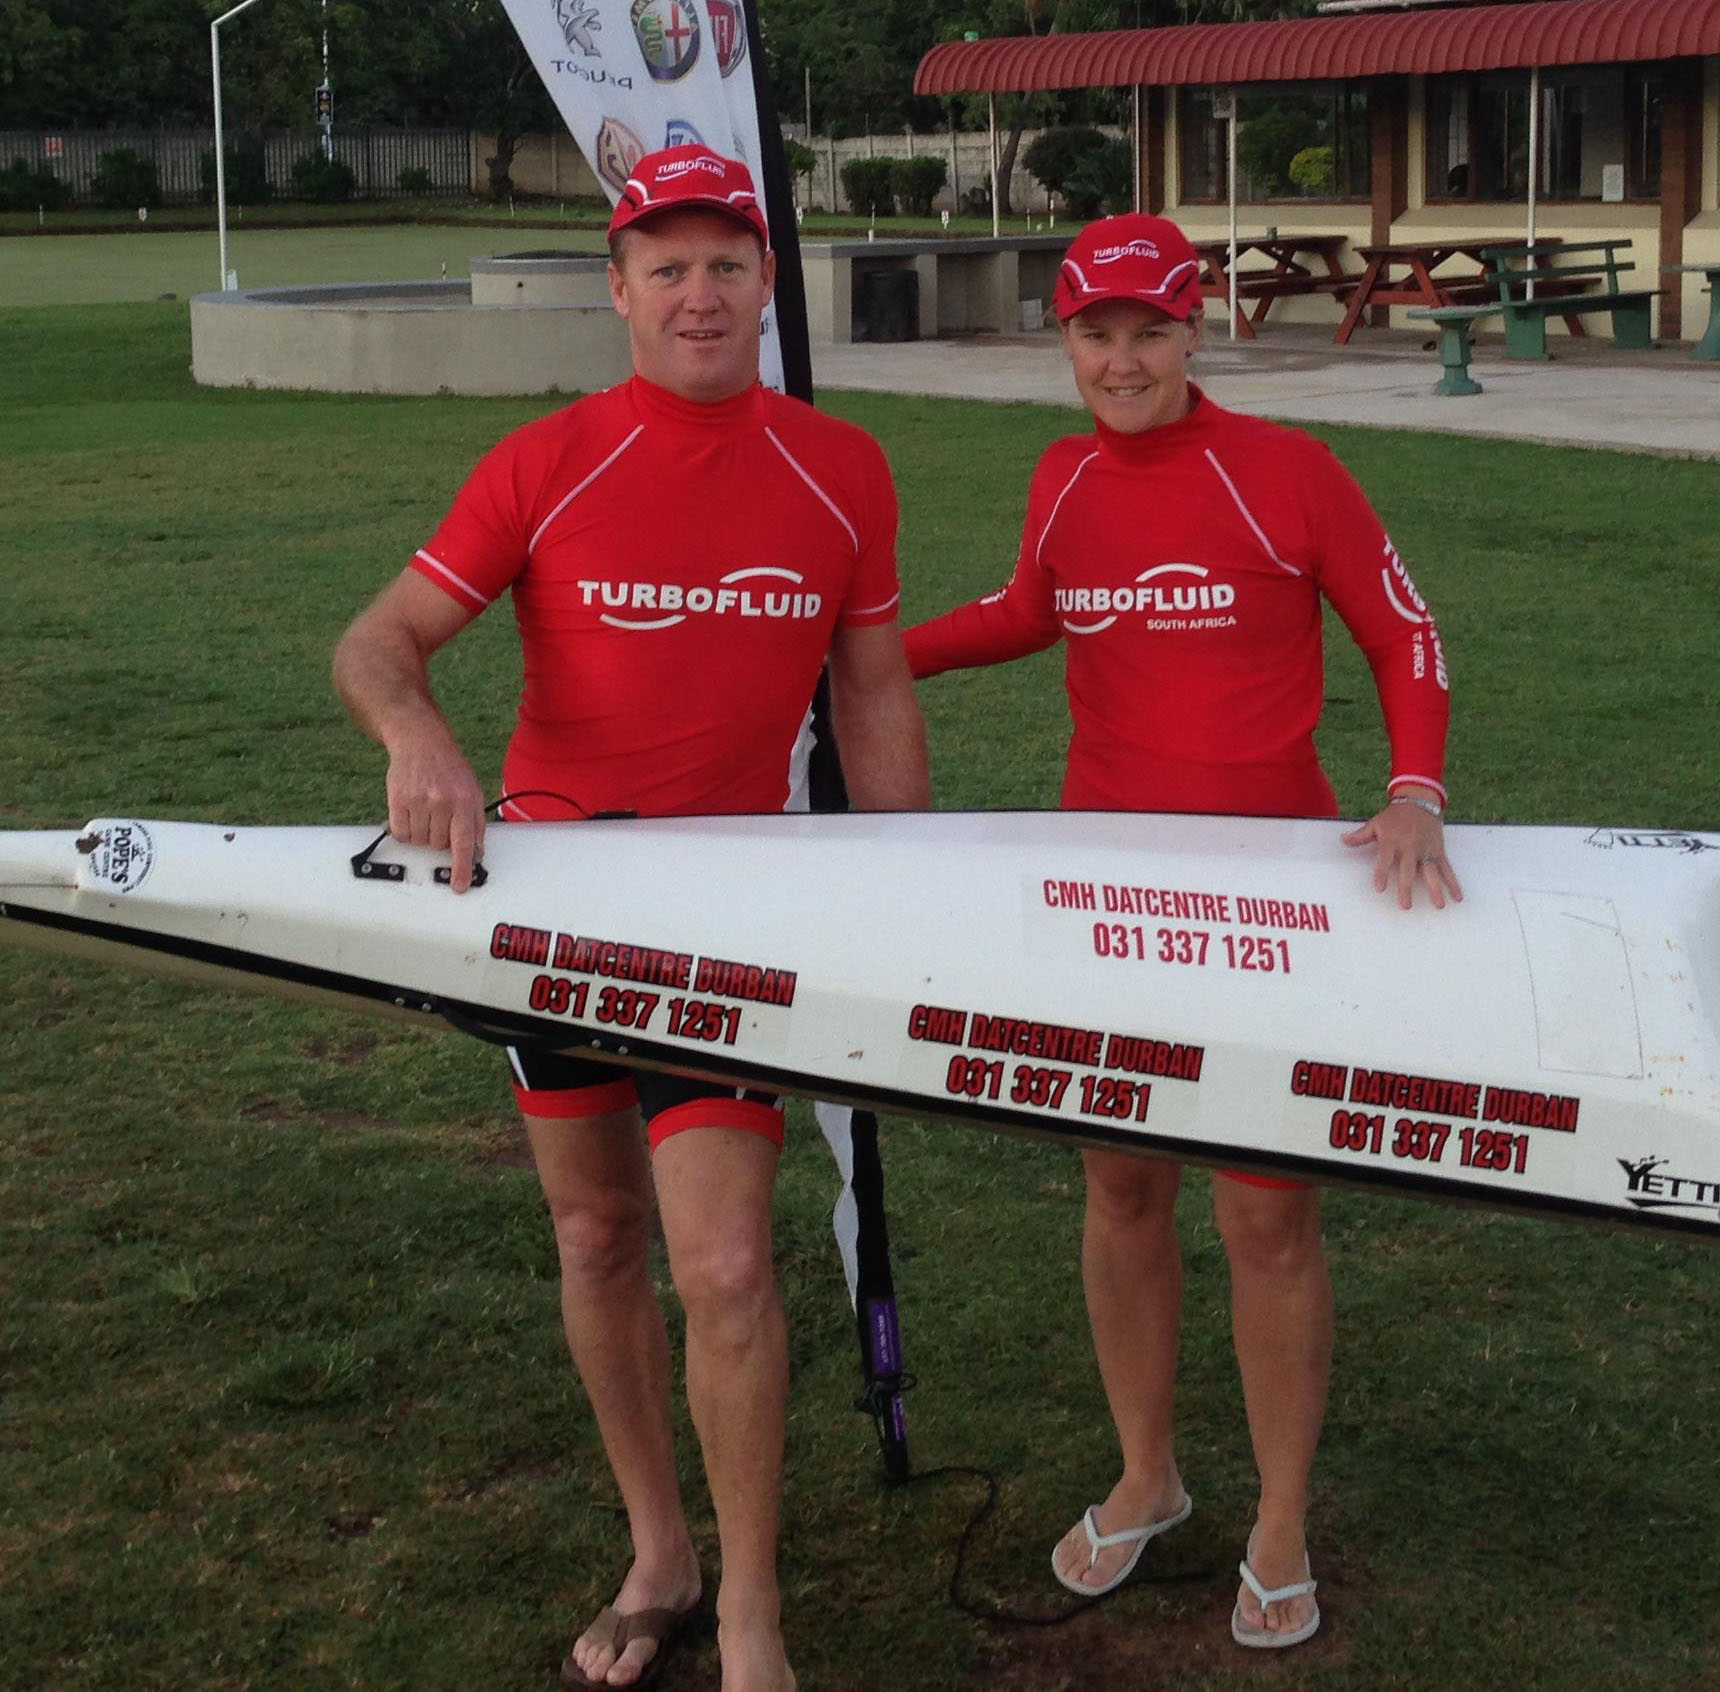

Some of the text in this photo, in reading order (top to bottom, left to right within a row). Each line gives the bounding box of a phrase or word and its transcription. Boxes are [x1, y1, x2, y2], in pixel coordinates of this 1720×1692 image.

[1093, 246, 1160, 259] TURBOFLUID
[577, 580, 822, 618] TURBOFLUID
[1055, 583, 1235, 612] TURBOFLUID
[1146, 616, 1237, 630] SOUTH AFRICA
[1043, 879, 1330, 932] CMH DATCENTRE DURBAN
[490, 923, 798, 1008] CMH DATCENTRE DURBAN
[1093, 922, 1291, 974] 031 337 1251
[529, 975, 742, 1045] 031 337 1251
[908, 1004, 1205, 1082] CMH DATCENTRE DURBAN
[946, 1055, 1152, 1123] 031 337 1251
[1291, 1060, 1580, 1133] CMH DATCENTRE DURBAN
[1329, 1109, 1529, 1175] 031 337 1251
